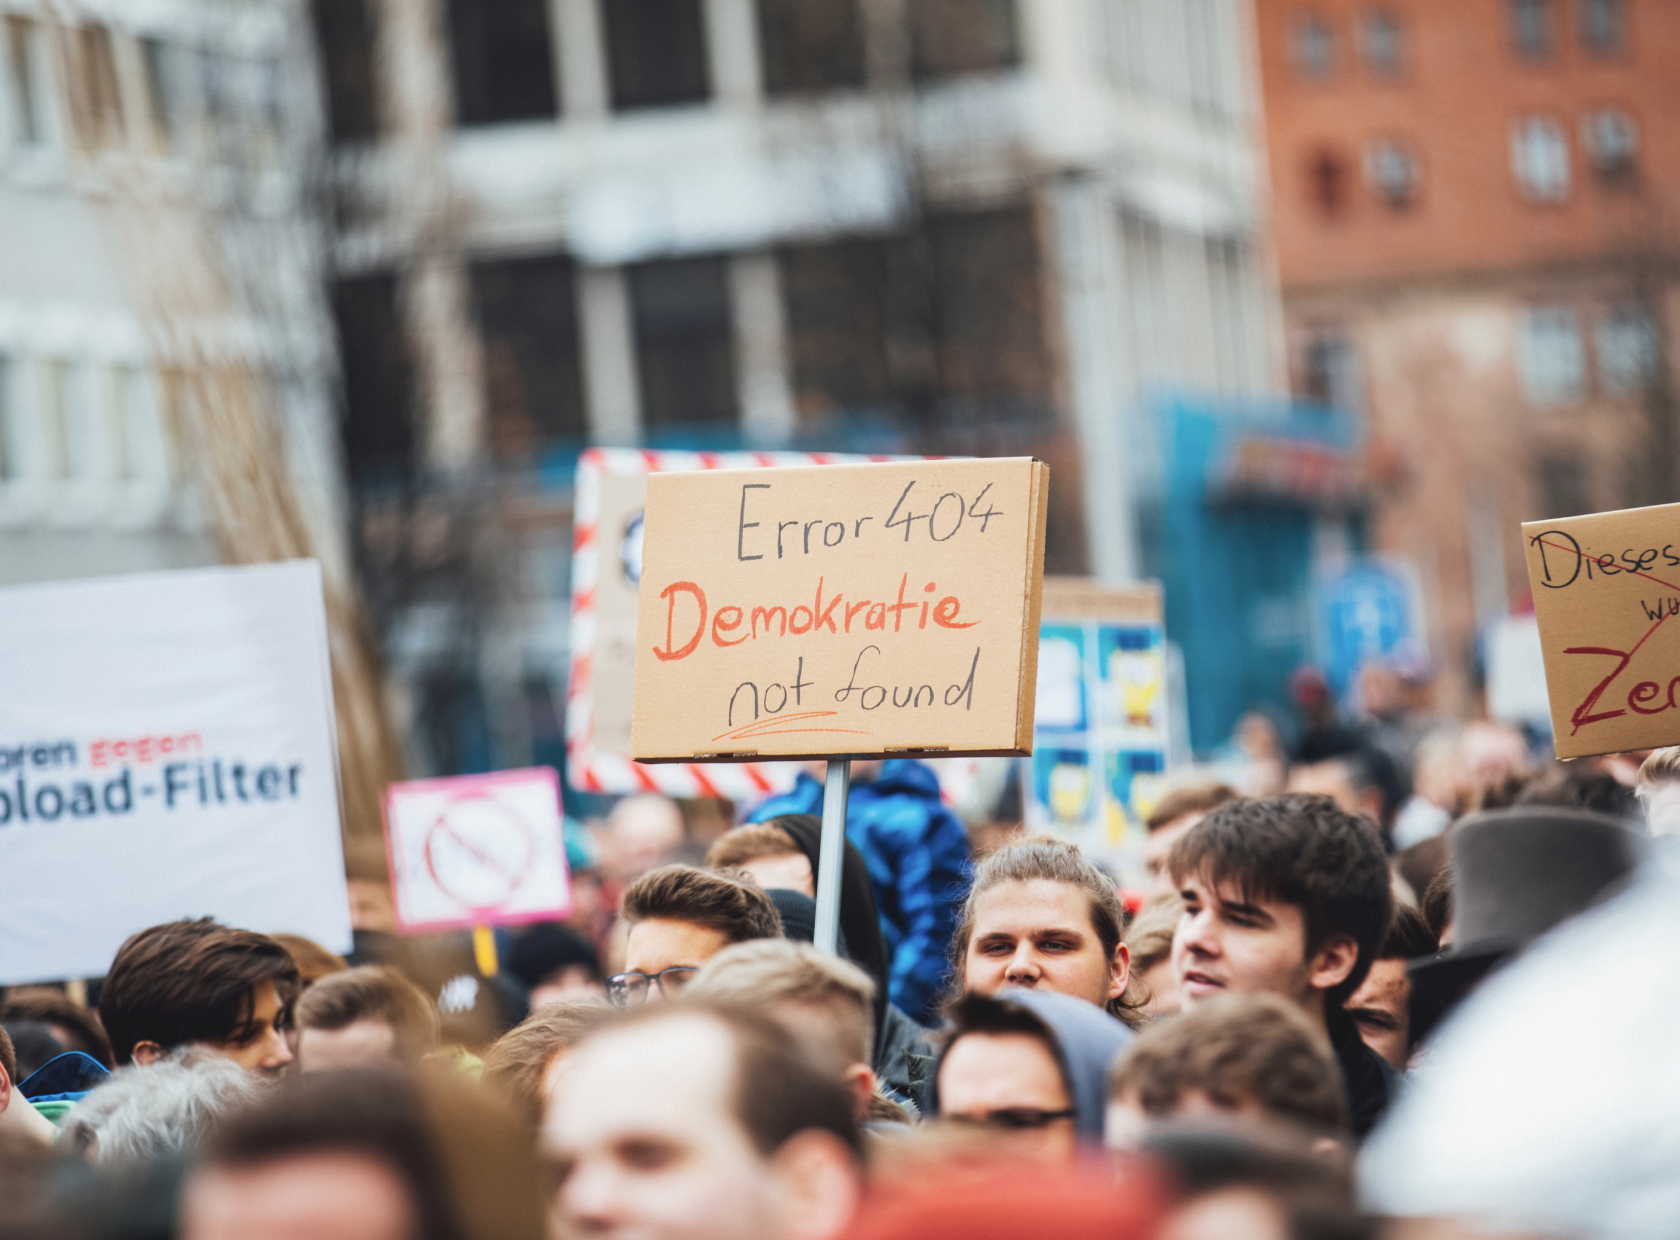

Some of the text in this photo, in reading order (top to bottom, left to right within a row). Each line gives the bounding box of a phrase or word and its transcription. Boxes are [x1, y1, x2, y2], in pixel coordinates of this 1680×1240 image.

[738, 480, 1004, 561] Error 404
[1530, 530, 1680, 588] Dieses
[652, 572, 982, 661] Demokratie
[728, 645, 980, 726] not found
